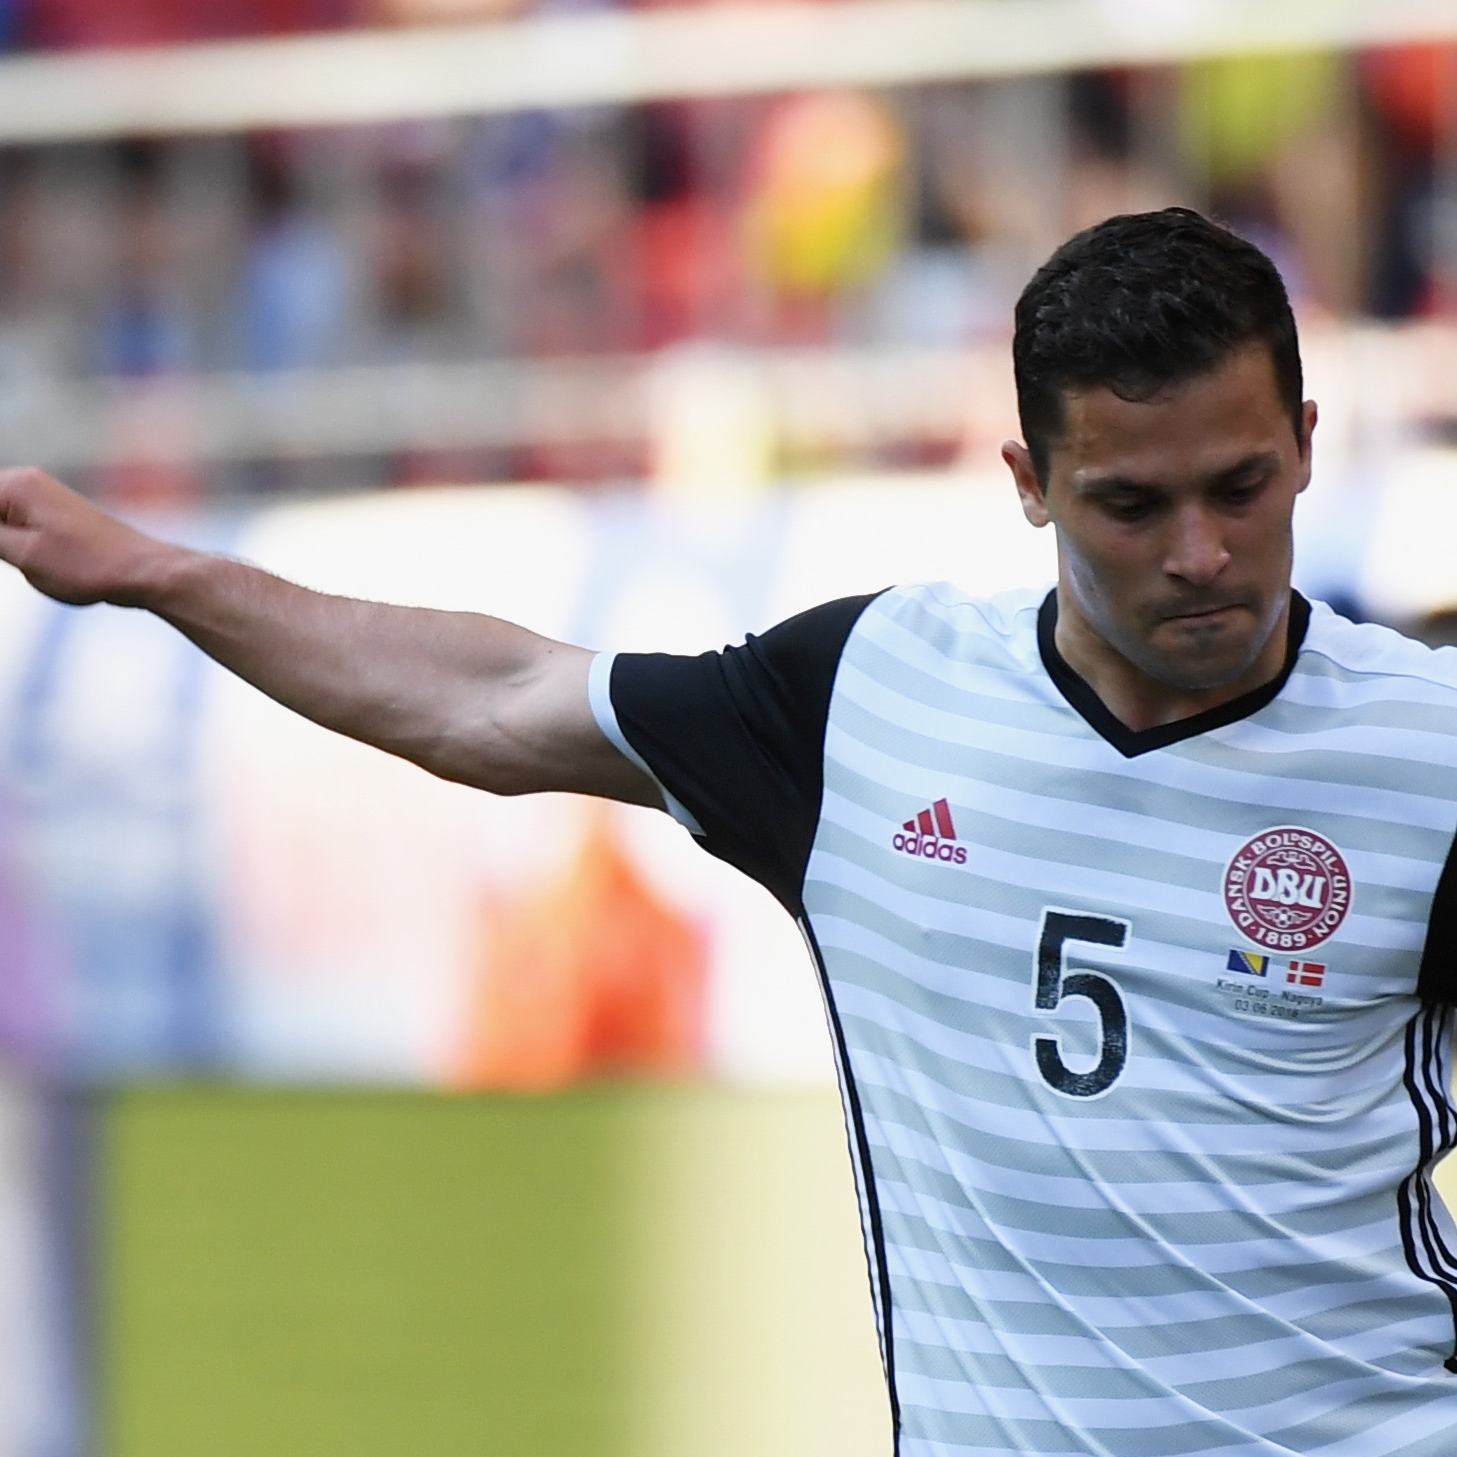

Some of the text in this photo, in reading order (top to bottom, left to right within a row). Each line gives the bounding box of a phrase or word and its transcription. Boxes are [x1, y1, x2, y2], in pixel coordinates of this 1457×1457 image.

[892, 832, 968, 865] adidas
[1227, 855, 1253, 928] DANSK
[1311, 875, 1348, 938] UNION
[1248, 866, 1327, 909] DBU
[1254, 927, 1308, 948] 1889
[1033, 909, 1129, 1098] 5
[1216, 978, 1244, 993] Kirin
[1246, 984, 1270, 999] Cup
[1281, 989, 1323, 1008] Nagoya
